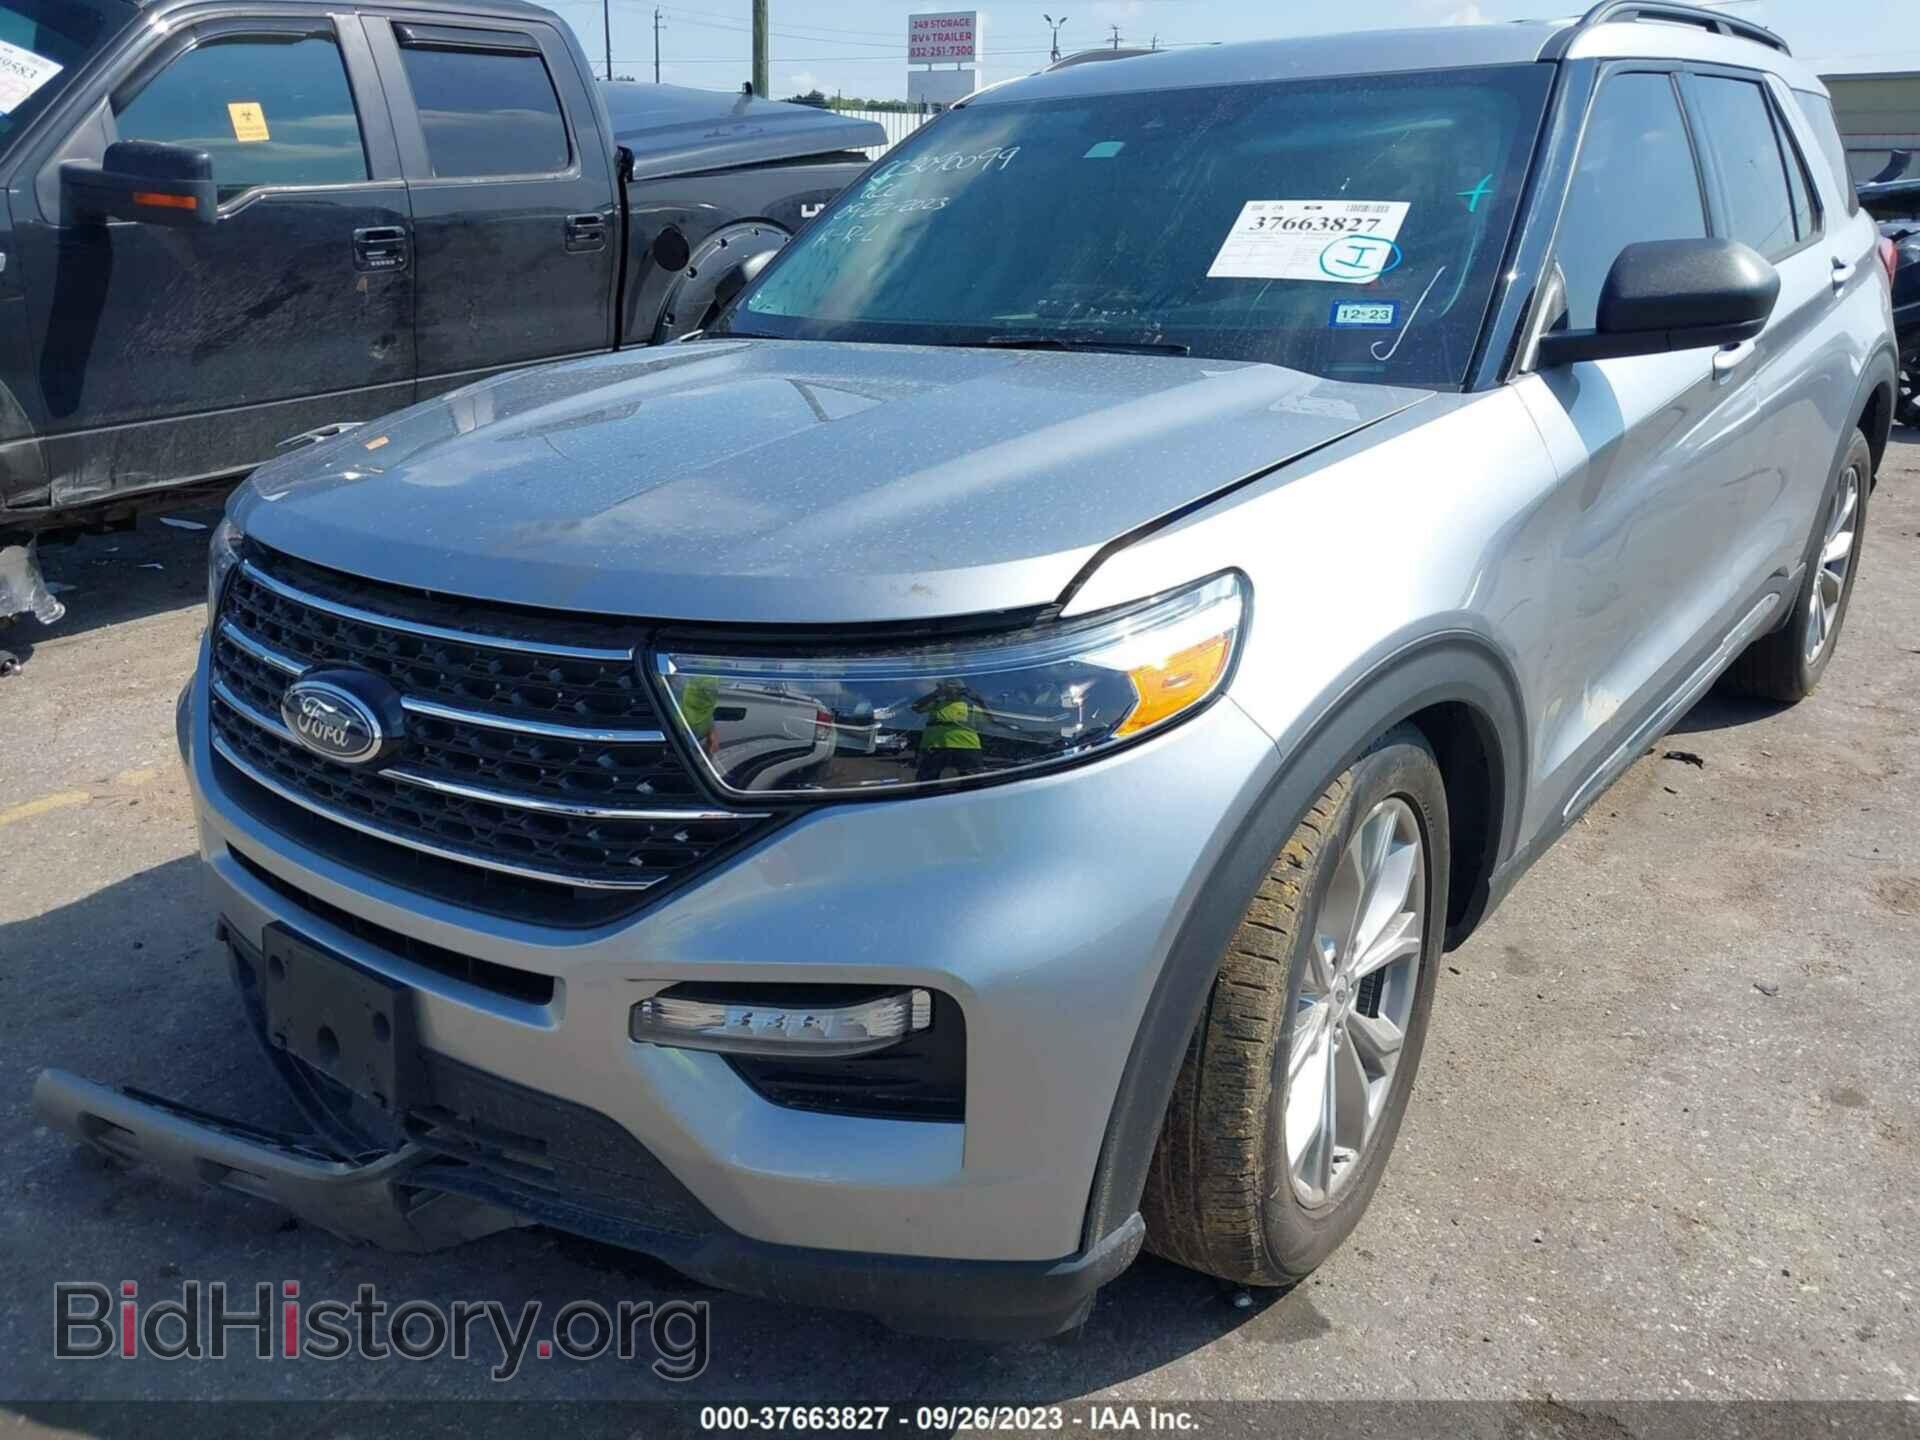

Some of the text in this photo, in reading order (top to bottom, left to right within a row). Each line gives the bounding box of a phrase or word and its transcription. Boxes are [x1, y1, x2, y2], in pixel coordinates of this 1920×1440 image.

[930, 18, 971, 29] STORAGE
[911, 34, 924, 43] RV
[931, 32, 972, 42] TRAILER
[1248, 216, 1382, 233] 37663827
[297, 696, 350, 747] Ford
